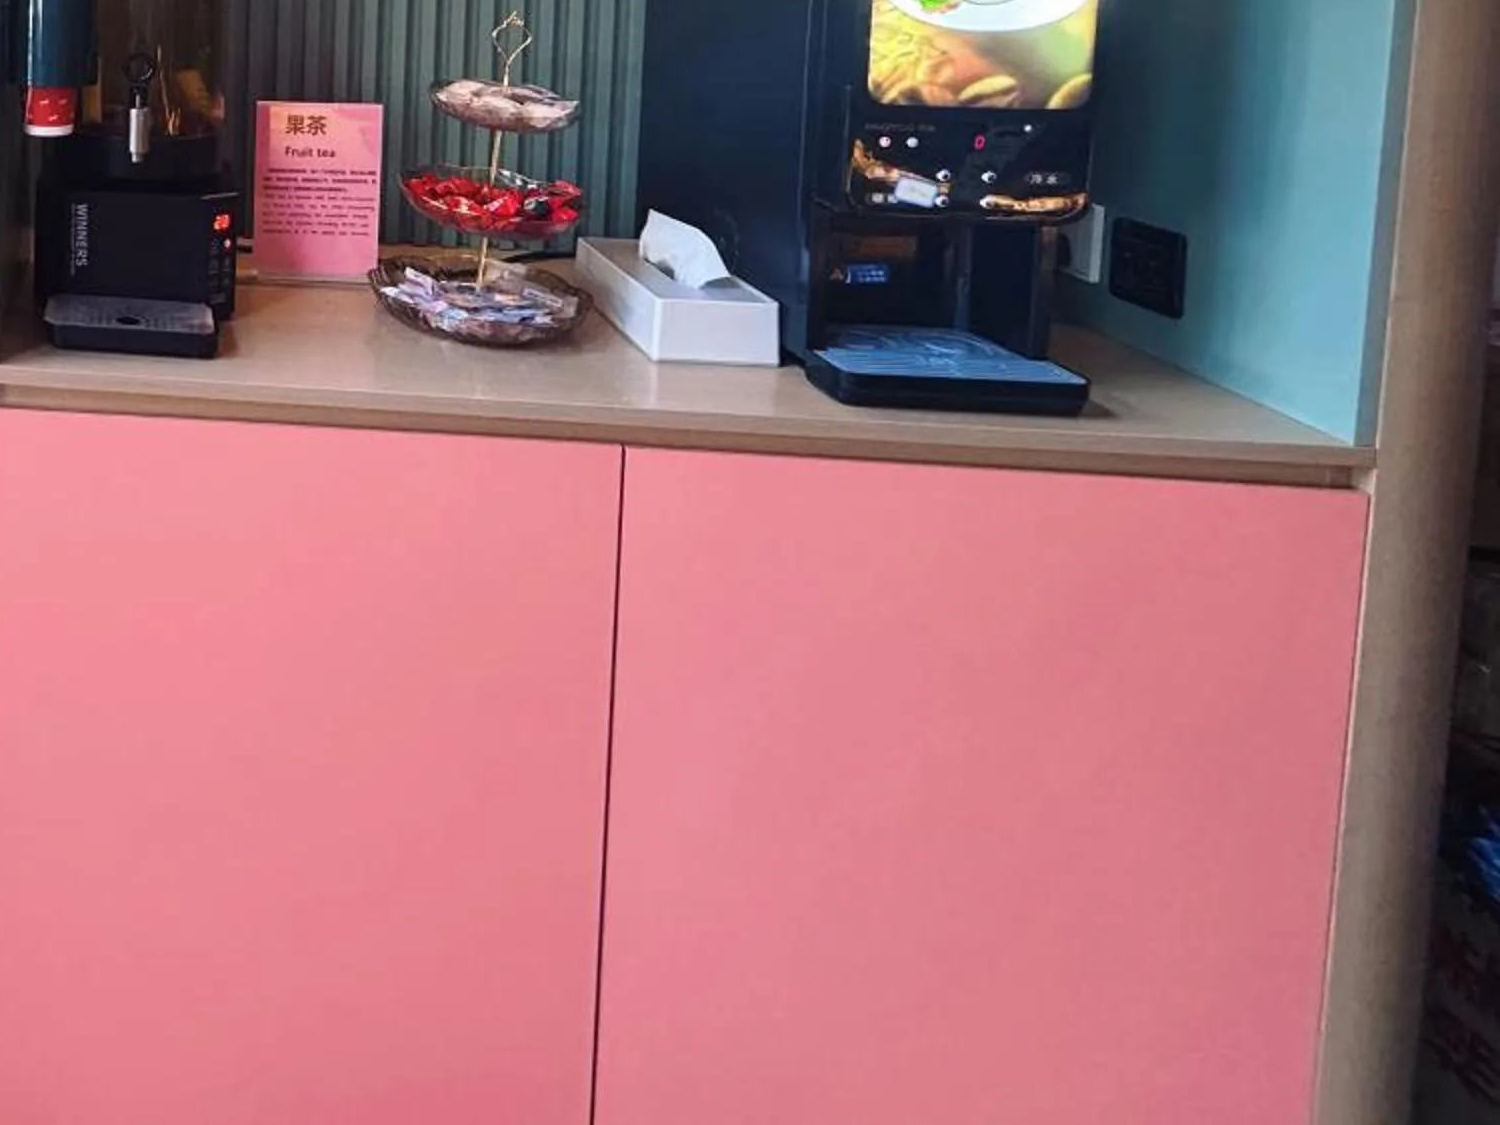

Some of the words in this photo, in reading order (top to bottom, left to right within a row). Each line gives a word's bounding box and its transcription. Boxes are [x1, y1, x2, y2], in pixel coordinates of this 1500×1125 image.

[285, 115, 327, 136] 果茶
[285, 146, 314, 158] Fruit
[317, 147, 336, 159] tea
[76, 203, 89, 267] WINNERS
